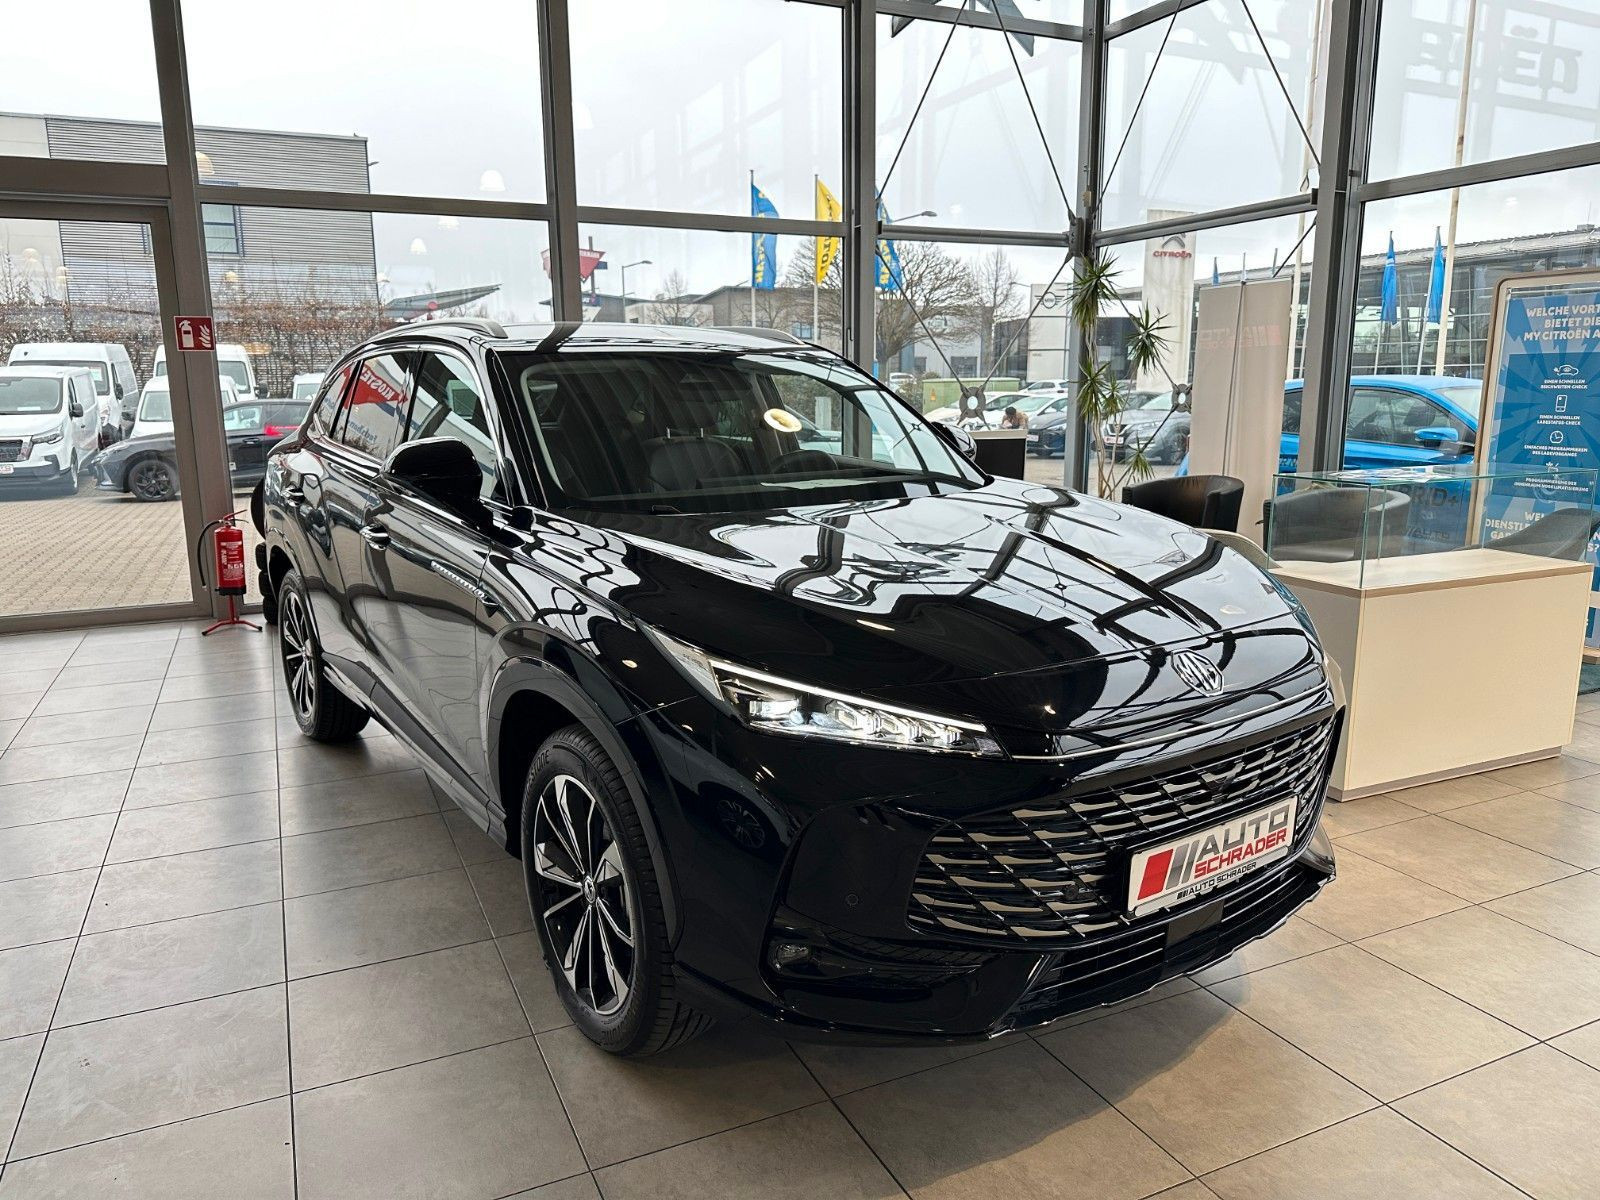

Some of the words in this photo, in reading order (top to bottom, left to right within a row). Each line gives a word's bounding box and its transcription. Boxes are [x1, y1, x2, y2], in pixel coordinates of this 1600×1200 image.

[1526, 306, 1570, 318] WELCHE
[1544, 318, 1581, 328] BIETET
[1523, 331, 1541, 341] MY
[1542, 327, 1590, 340] CITROËN
[1196, 804, 1290, 863] AUTO
[1193, 828, 1288, 880] SCHRADER
[1188, 879, 1215, 895] AUTO
[1216, 862, 1257, 883] SCHRADER
